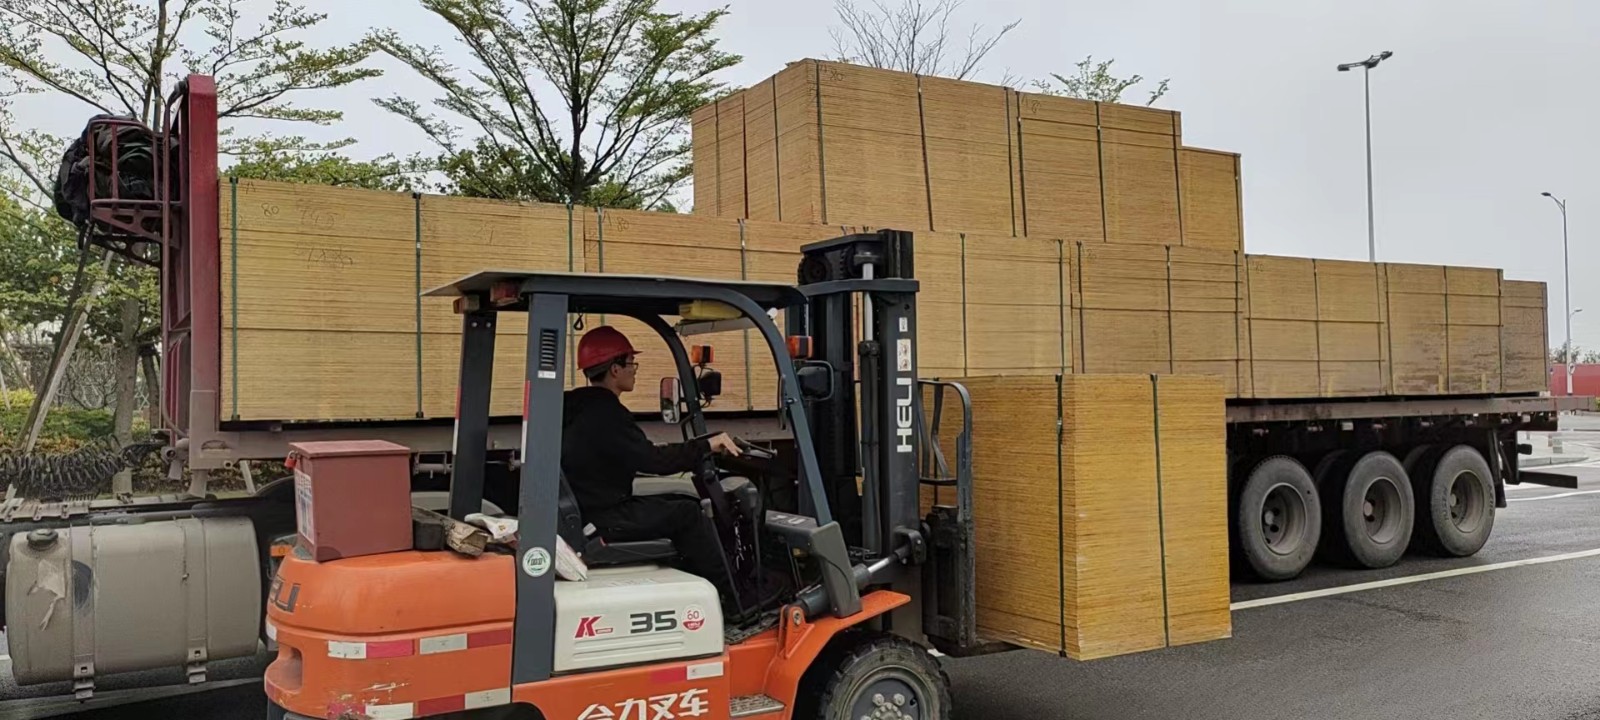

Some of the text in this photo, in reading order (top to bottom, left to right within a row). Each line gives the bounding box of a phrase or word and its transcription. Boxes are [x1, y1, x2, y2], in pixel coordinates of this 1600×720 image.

[261, 203, 280, 217] 80
[897, 377, 912, 453] HELI
[630, 610, 677, 634] 35
[687, 610, 700, 620] 60
[575, 616, 602, 638] K
